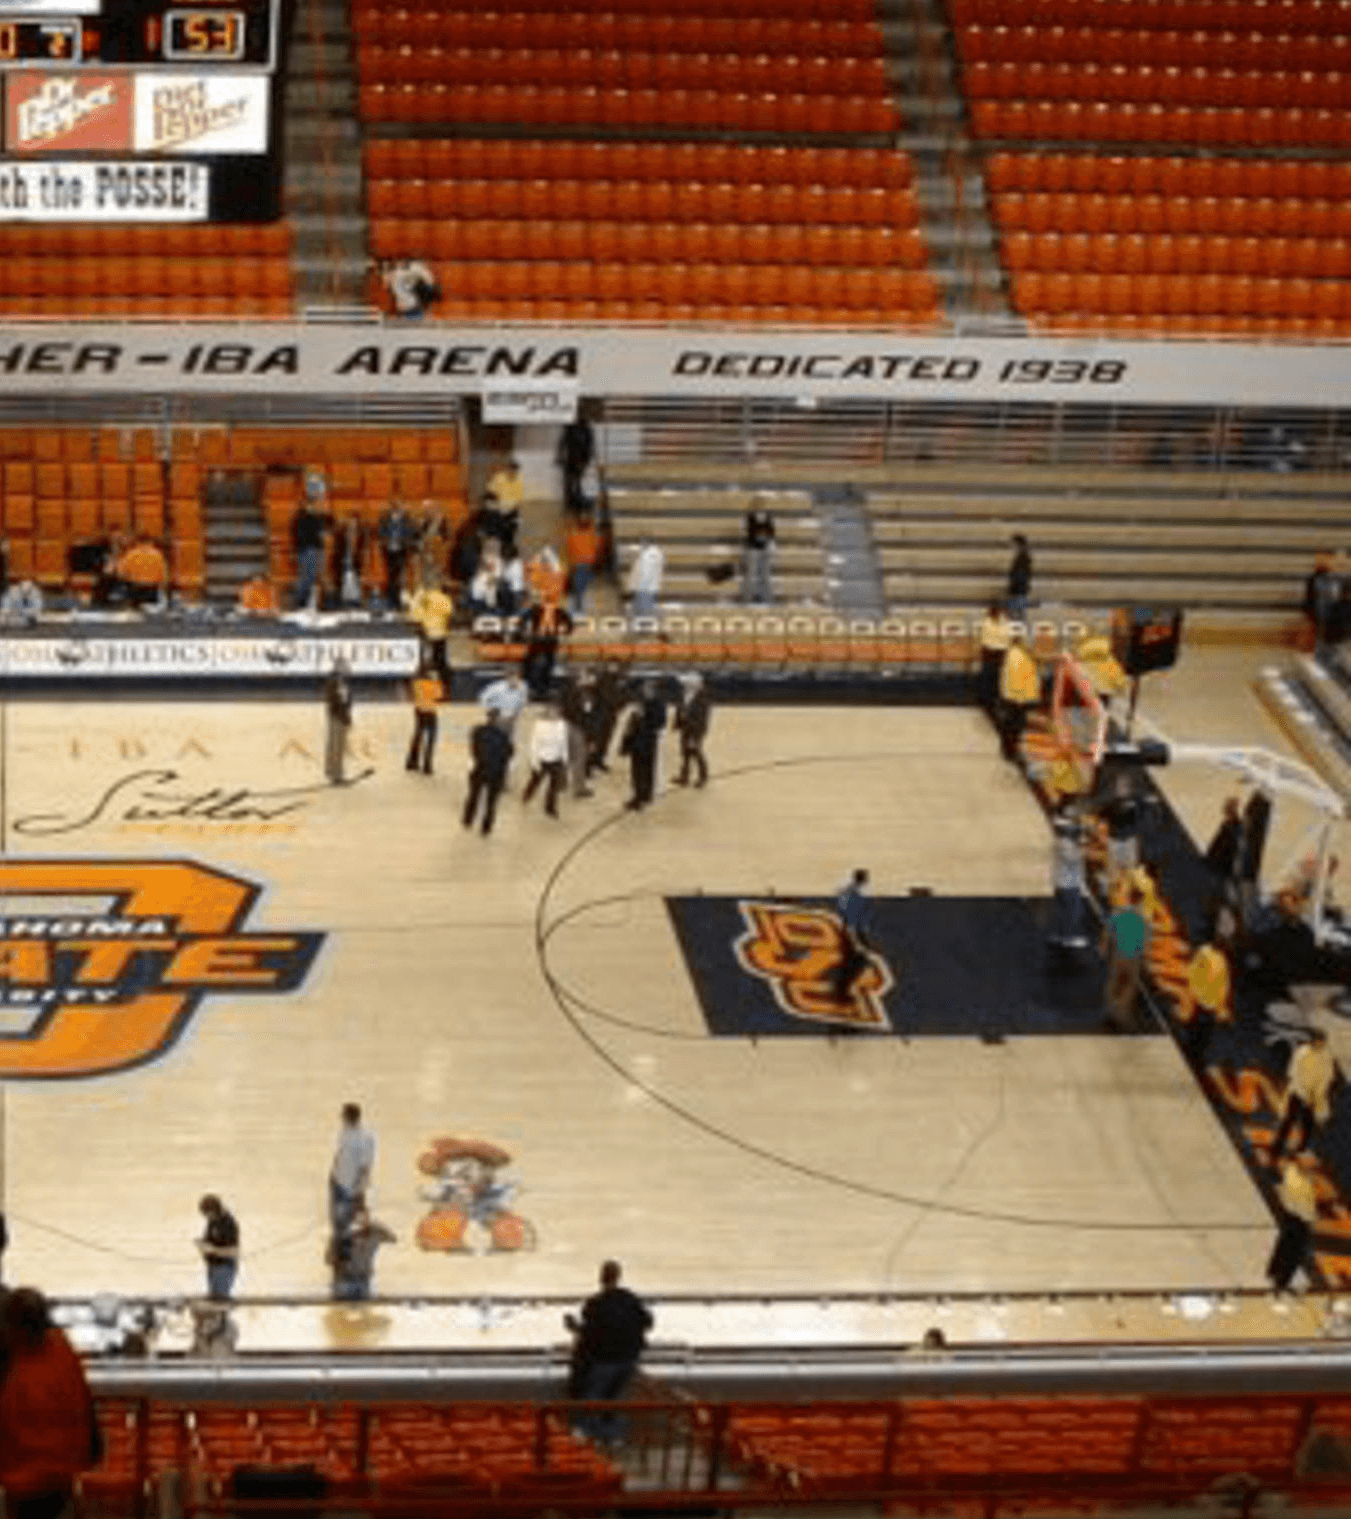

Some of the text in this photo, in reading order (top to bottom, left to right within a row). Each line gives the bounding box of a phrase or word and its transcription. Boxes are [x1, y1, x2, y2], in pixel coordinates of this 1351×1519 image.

[185, 14, 234, 52] 53
[40, 169, 82, 207] the
[96, 167, 199, 208] POSSE!
[335, 346, 581, 376] ARENA
[673, 352, 980, 380] DEDICATED
[1000, 360, 1127, 383] 1938
